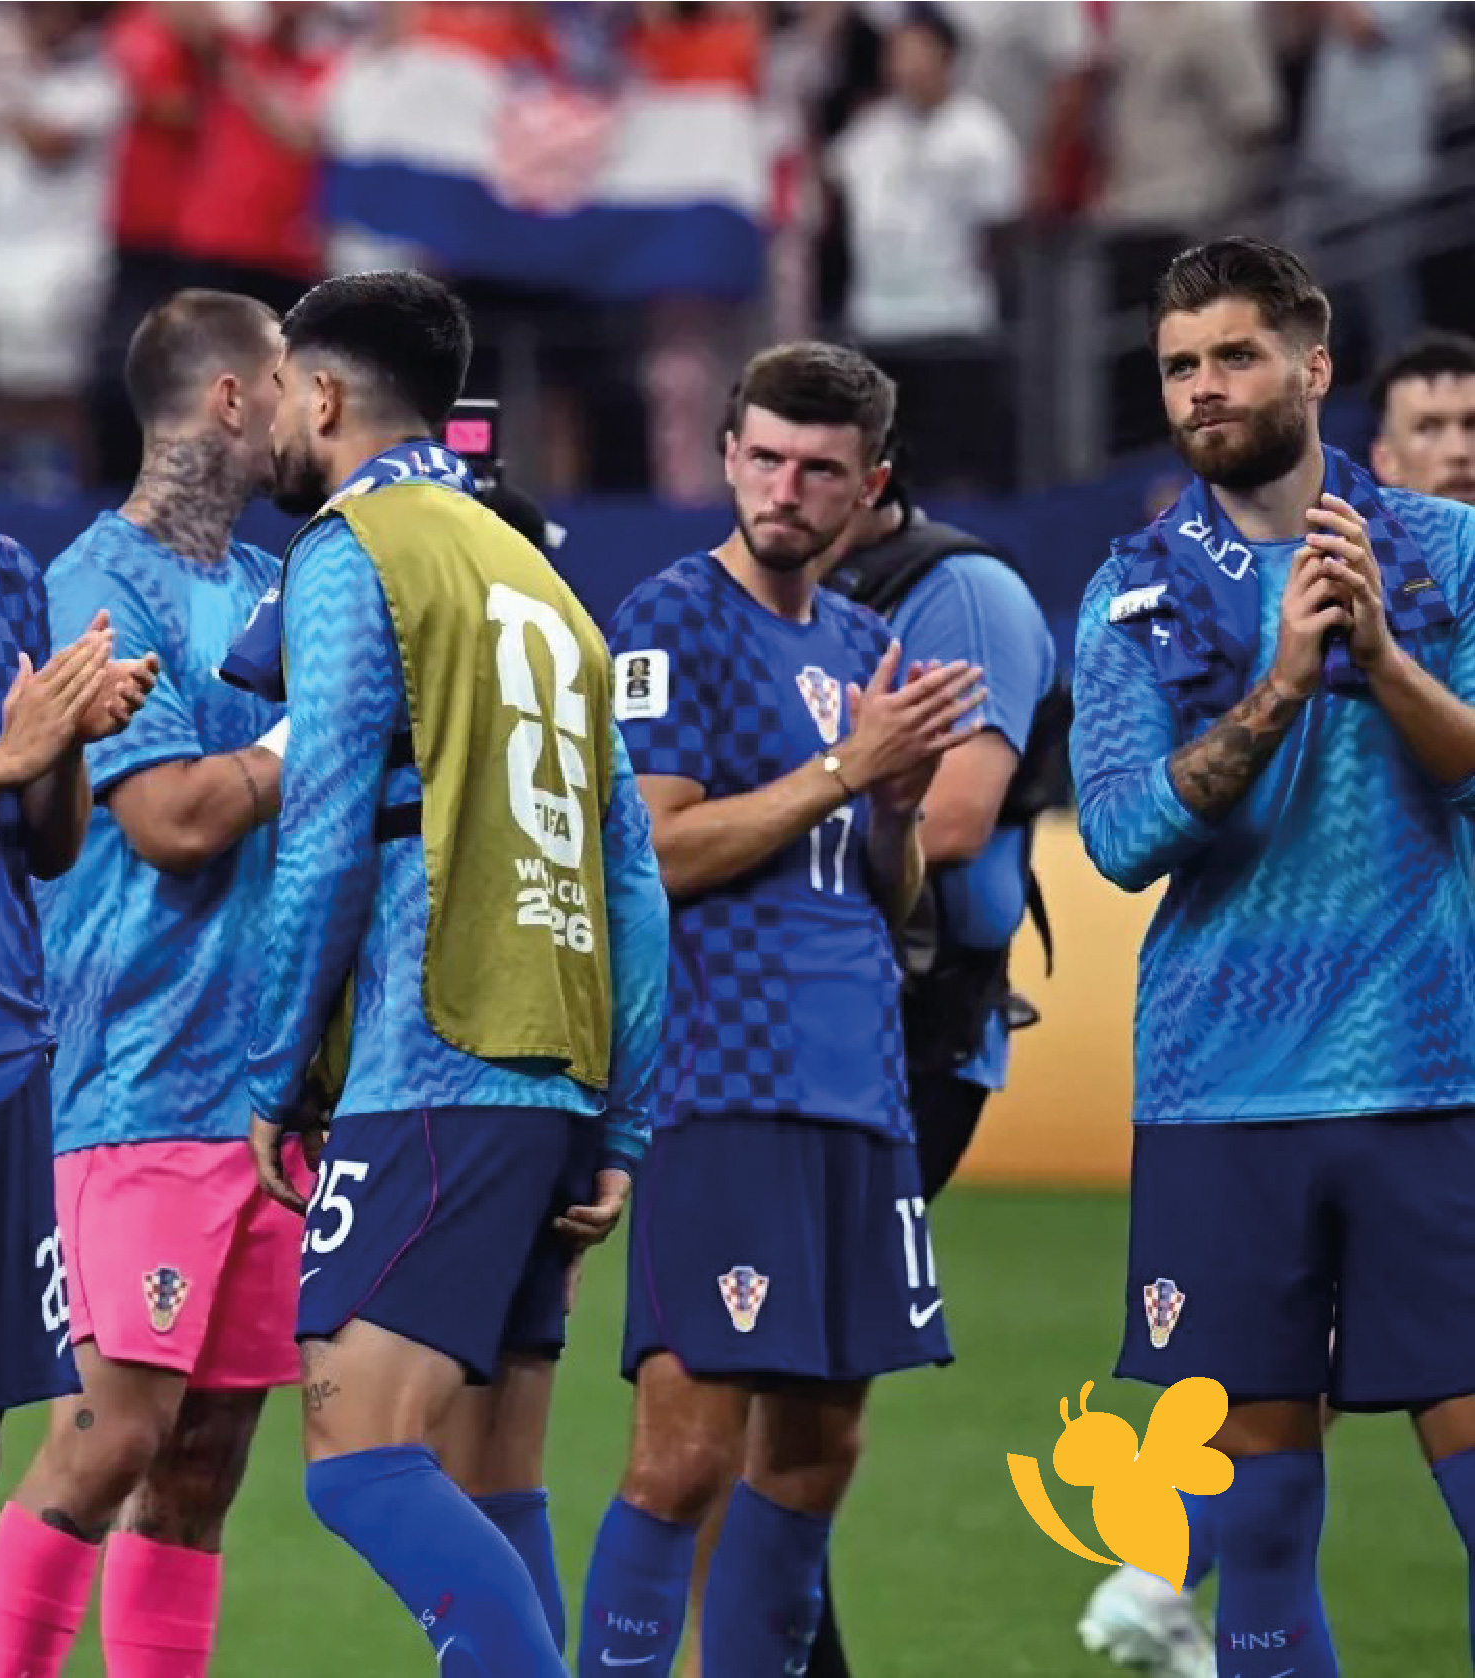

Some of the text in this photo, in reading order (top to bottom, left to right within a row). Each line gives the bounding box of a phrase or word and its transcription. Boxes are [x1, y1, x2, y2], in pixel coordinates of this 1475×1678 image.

[809, 806, 854, 895] 17
[516, 888, 594, 953] 226
[607, 1611, 659, 1636] HNS
[1230, 1629, 1286, 1650] HNS
